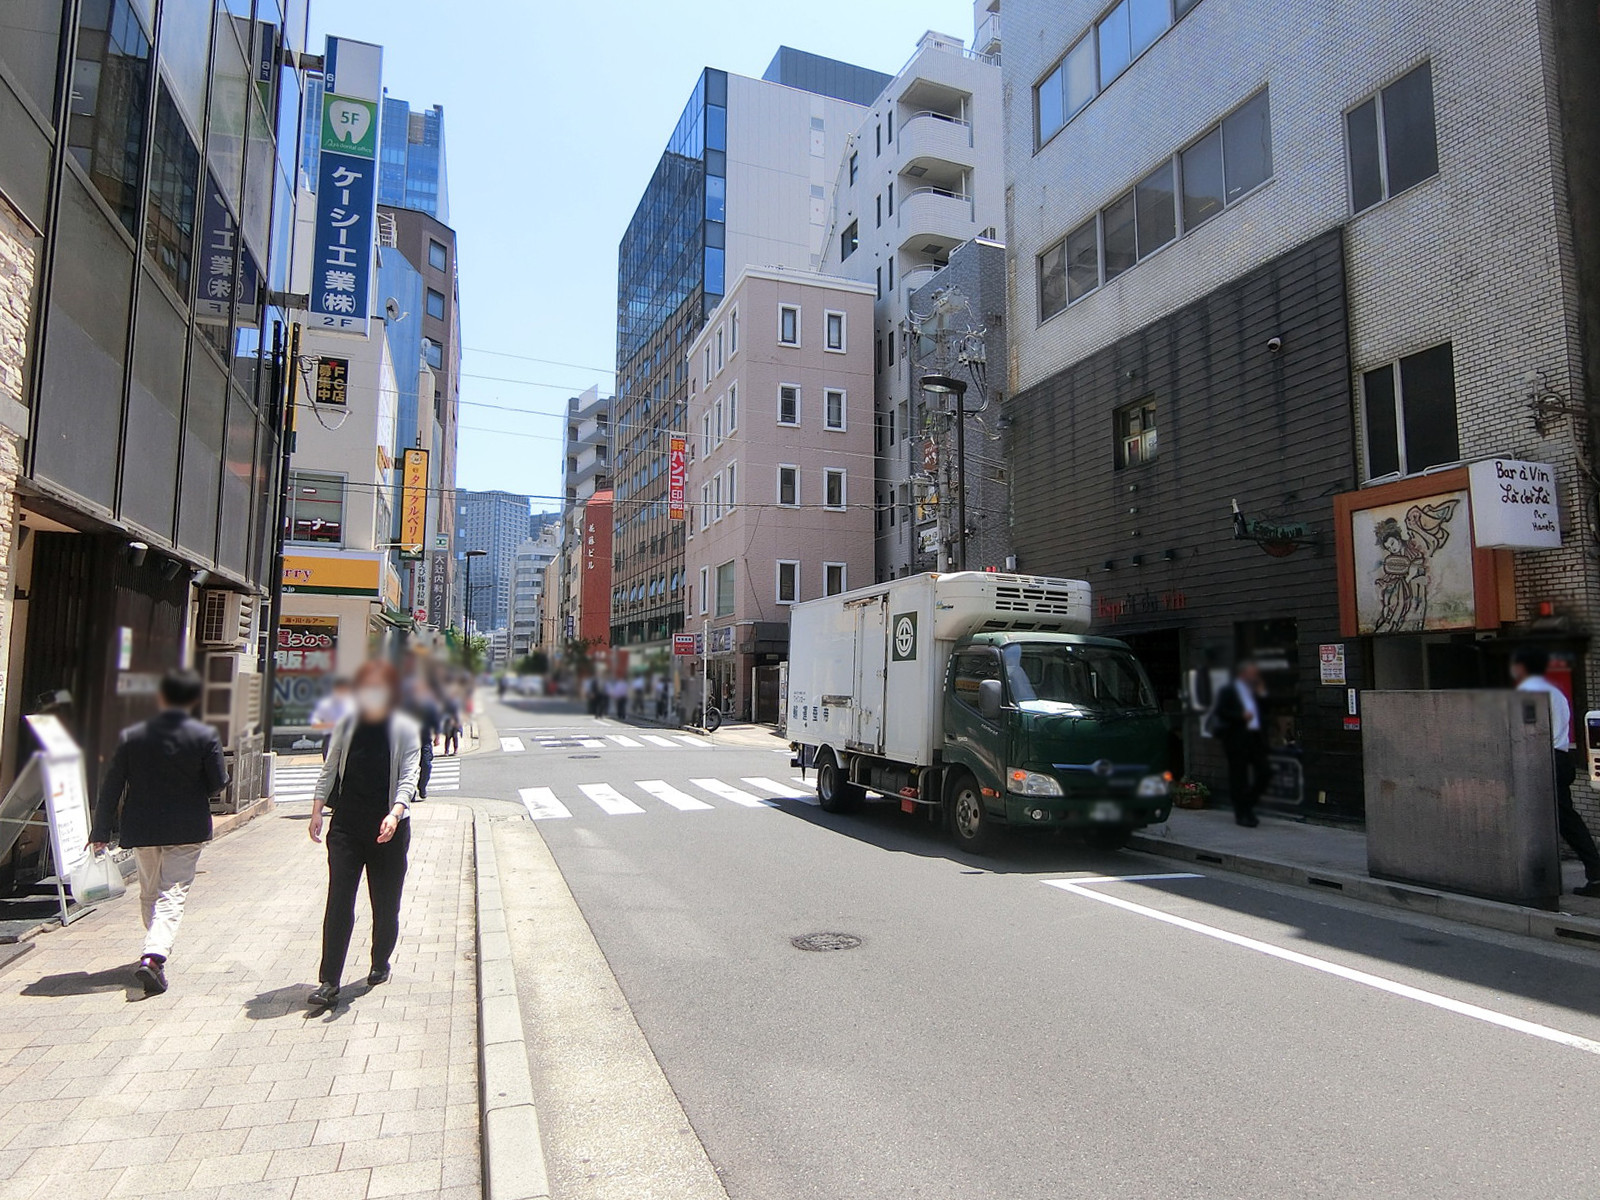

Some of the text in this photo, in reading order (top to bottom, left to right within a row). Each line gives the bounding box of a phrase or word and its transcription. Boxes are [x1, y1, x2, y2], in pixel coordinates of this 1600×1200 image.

[340, 110, 360, 126] 5F
[323, 316, 353, 328] 2F
[317, 364, 332, 401] 募集中
[1495, 461, 1550, 483] Bar à Vin
[283, 568, 314, 583] rry
